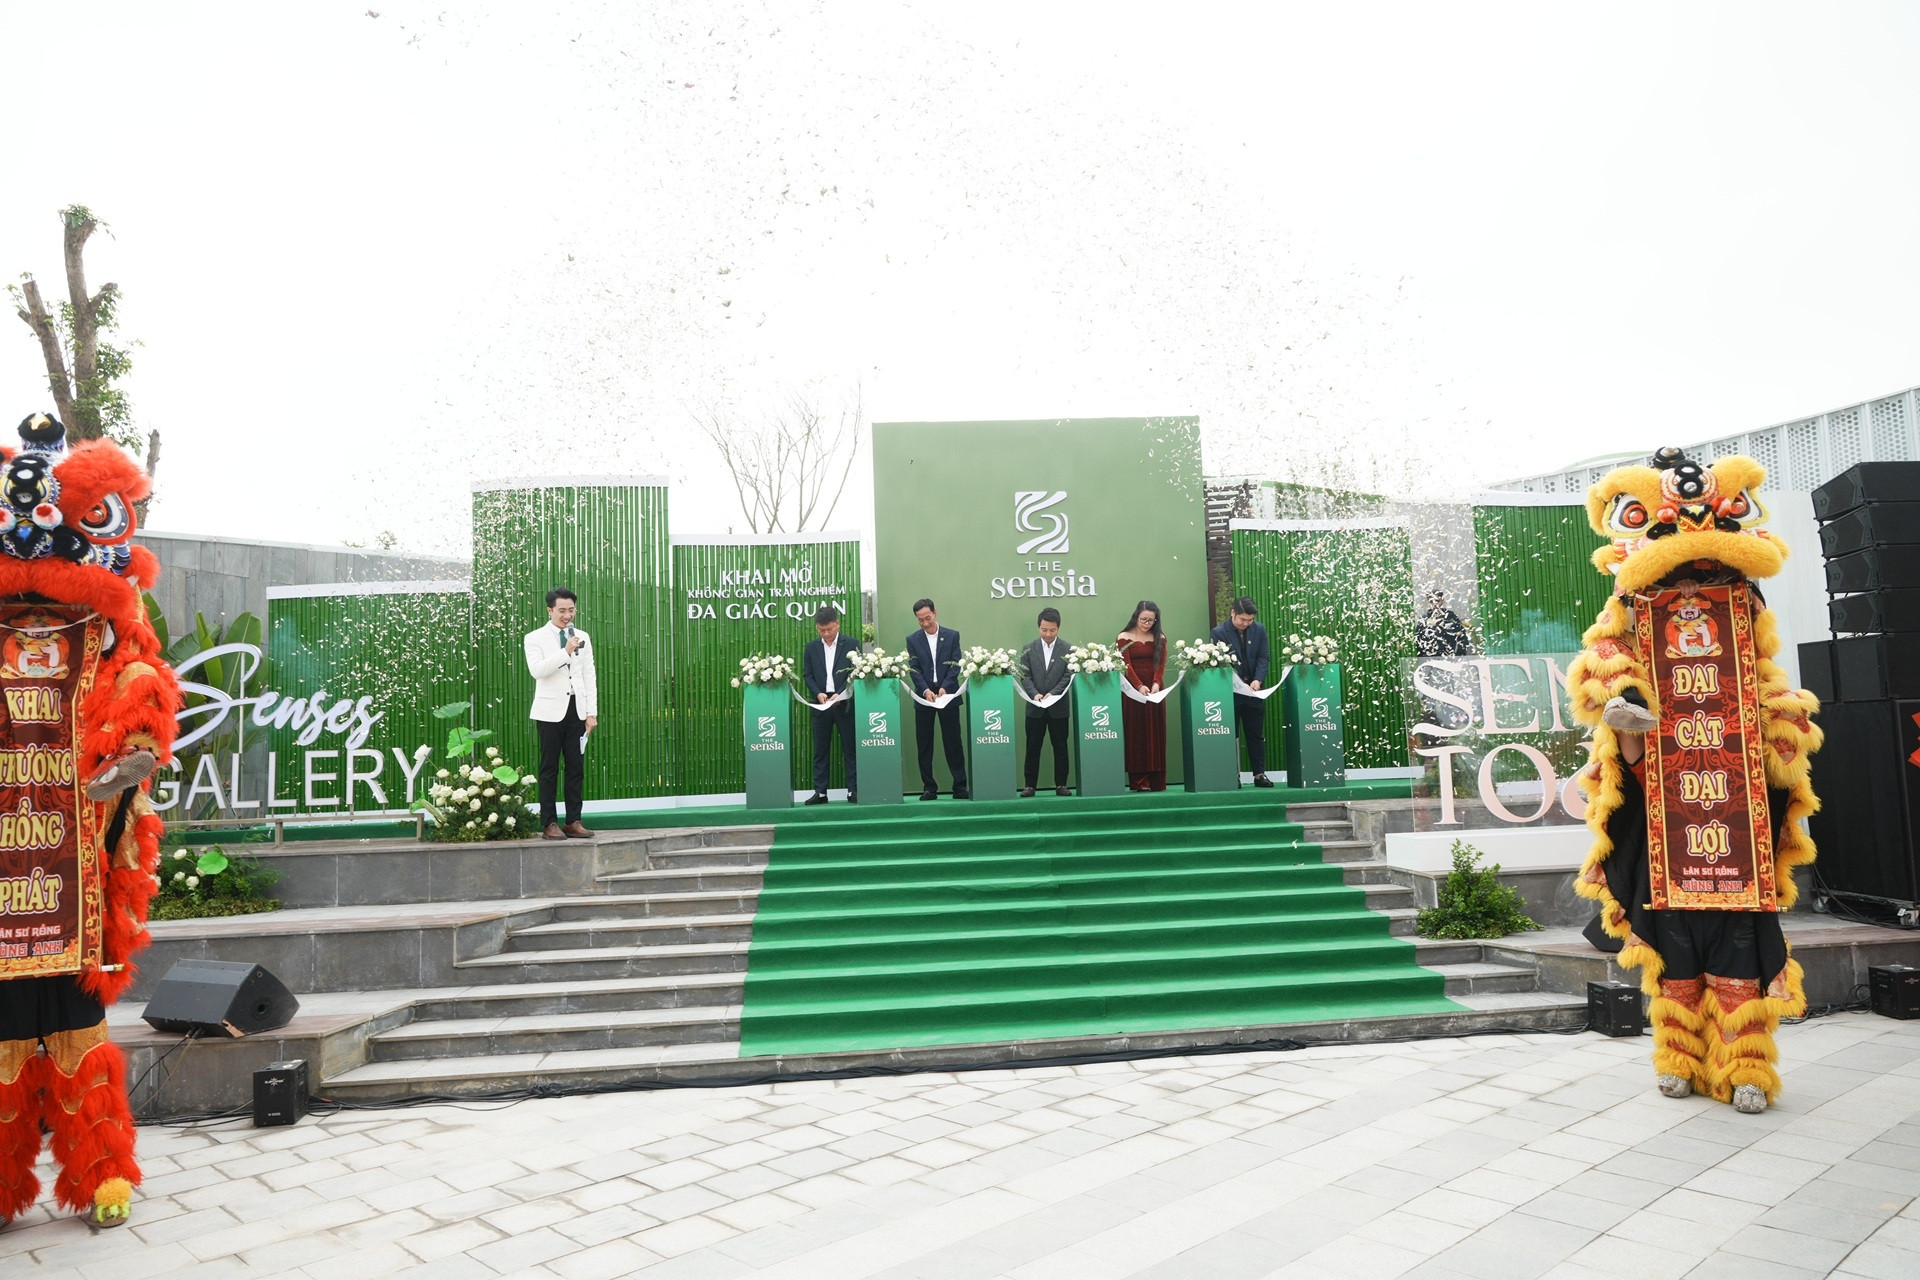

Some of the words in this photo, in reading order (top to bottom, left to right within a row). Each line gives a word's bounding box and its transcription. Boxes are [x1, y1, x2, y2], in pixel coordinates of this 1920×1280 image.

[722, 569, 771, 586] KHAI
[779, 561, 813, 584] MỞ
[1025, 561, 1062, 572] THE
[687, 586, 731, 599] KHÔNG
[735, 588, 765, 599] GIAN
[798, 583, 847, 599] NGHIỆM
[990, 568, 1098, 599] sensia
[687, 603, 718, 620] ĐA
[725, 598, 778, 620] GIÁC
[1672, 663, 1719, 703] ĐẠI
[5, 687, 62, 724] KHAI
[170, 642, 386, 751] Senses
[1084, 729, 1118, 740] sensia
[1197, 725, 1231, 735] sensia
[1304, 721, 1337, 731] sensia
[1675, 710, 1724, 749] CÁT
[750, 741, 785, 751] sensia
[861, 736, 896, 747] sensia
[976, 734, 1010, 744] sensia
[147, 747, 432, 811] GALLERY
[1680, 770, 1729, 810] ĐẠI
[0, 797, 65, 849] HỒNG
[1686, 819, 1731, 864] LỢI
[1683, 866, 1700, 876] LÂN
[0, 867, 63, 916] PHÁT
[1682, 878, 1715, 892] HÙNG
[1717, 881, 1744, 892] ANH
[32, 940, 64, 955] ANH
